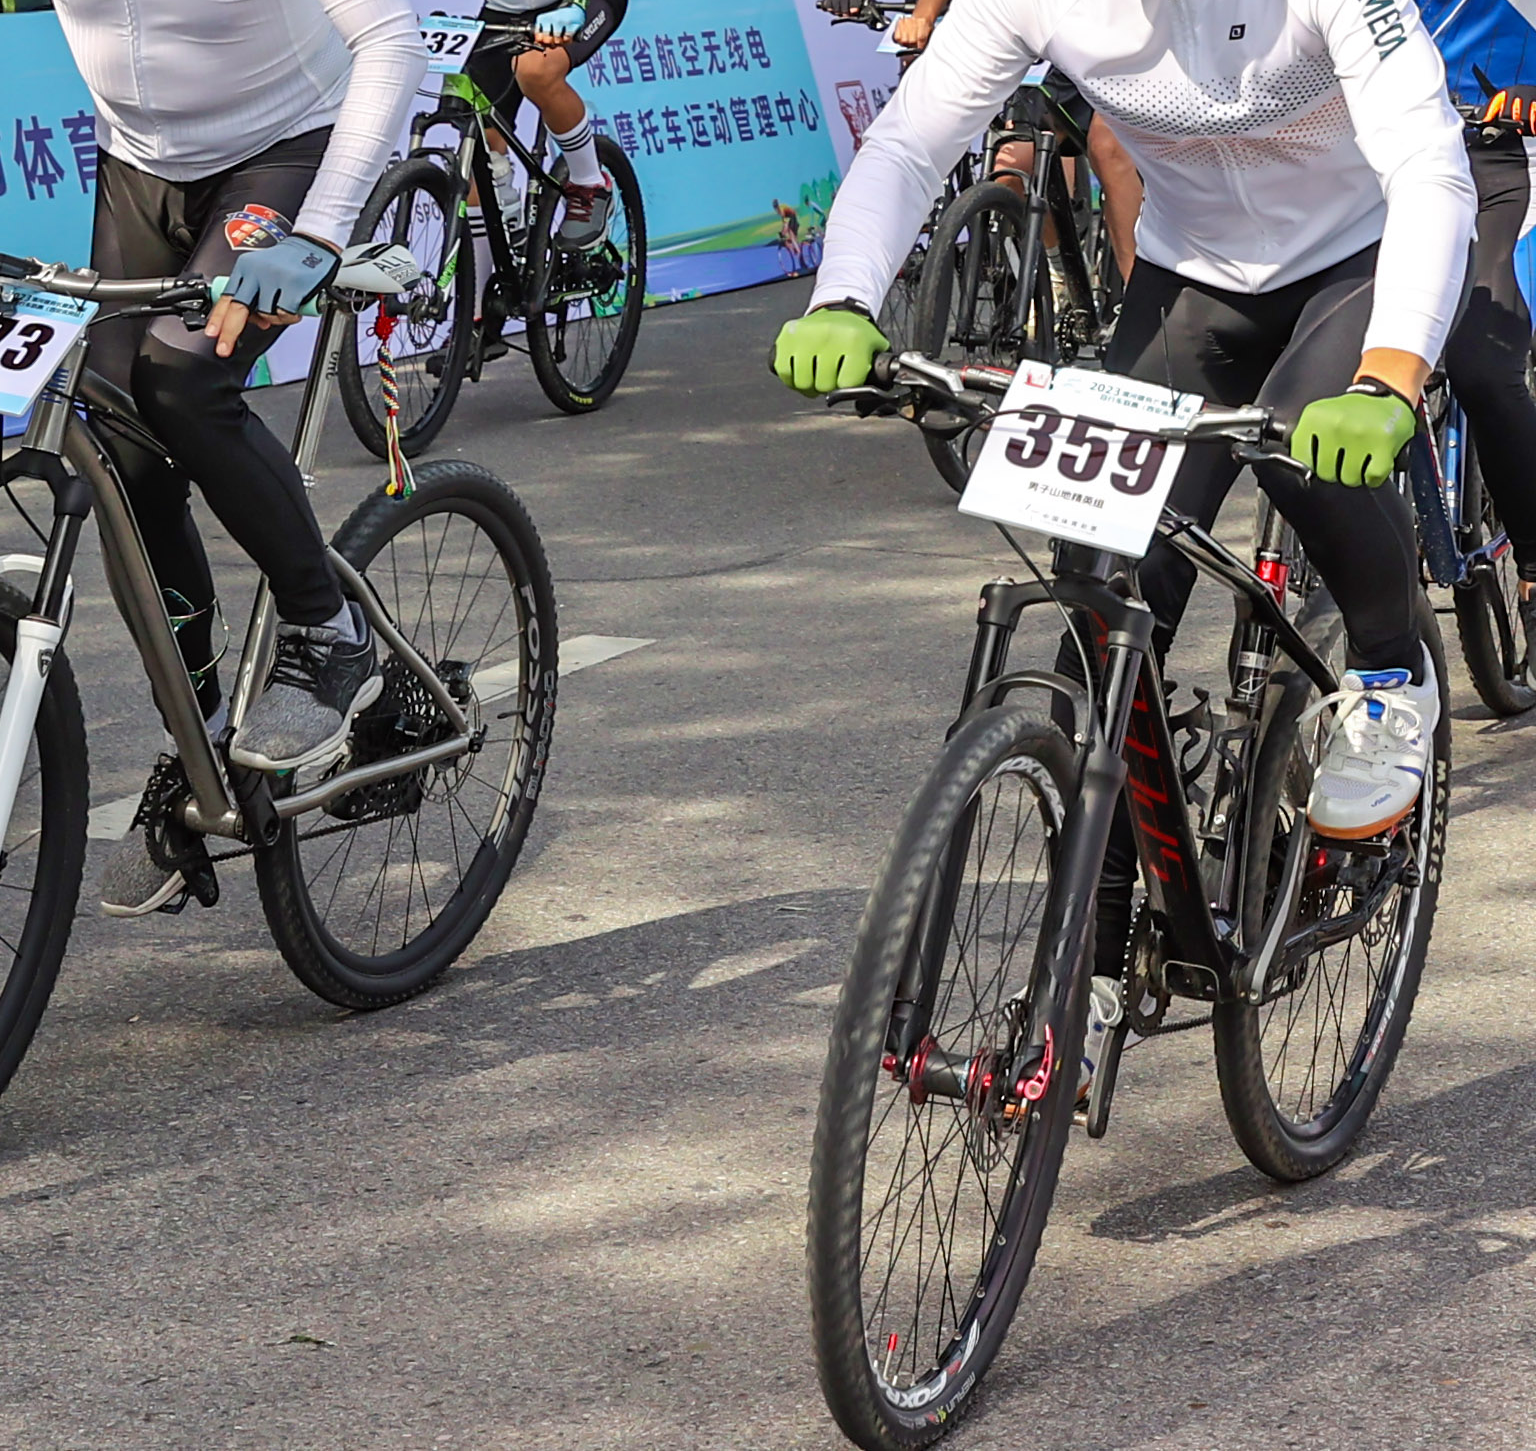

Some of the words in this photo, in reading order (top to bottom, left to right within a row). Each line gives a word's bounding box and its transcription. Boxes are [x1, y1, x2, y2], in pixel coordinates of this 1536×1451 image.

[586, 26, 772, 88] 陕西省航空无线电
[373, 256, 411, 273] ALL
[1005, 403, 1168, 496] 359
[1427, 758, 1449, 884] MAXXIS
